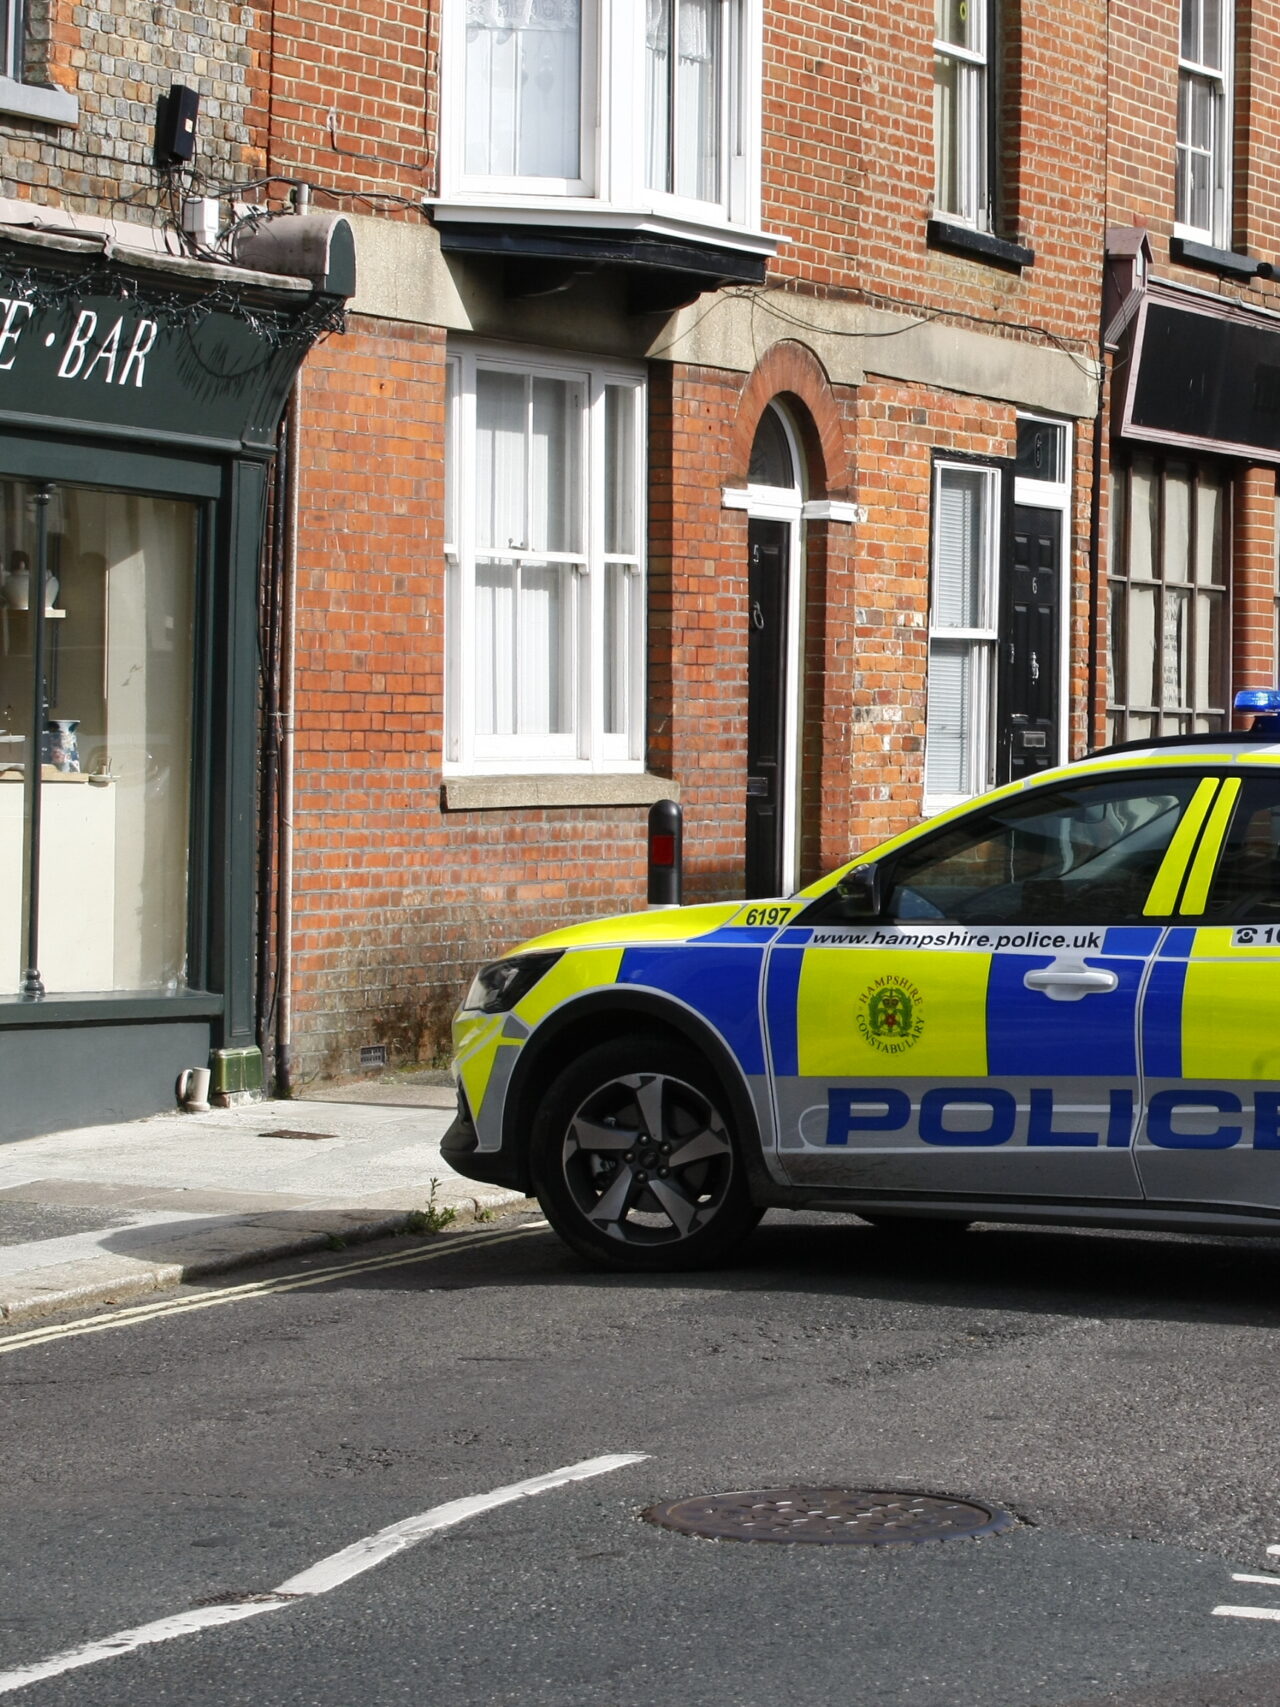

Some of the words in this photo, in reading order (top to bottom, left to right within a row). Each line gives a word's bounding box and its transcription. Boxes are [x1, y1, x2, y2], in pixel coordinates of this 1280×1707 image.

[0, 298, 34, 371] E
[58, 309, 158, 388] BAR
[1032, 577, 1038, 595] 6
[745, 906, 791, 926] 6197
[812, 931, 1102, 950] www.hampshire.police.uk
[858, 975, 923, 1006] HAMPSHIRE
[856, 1014, 925, 1054] CONSTABULARY
